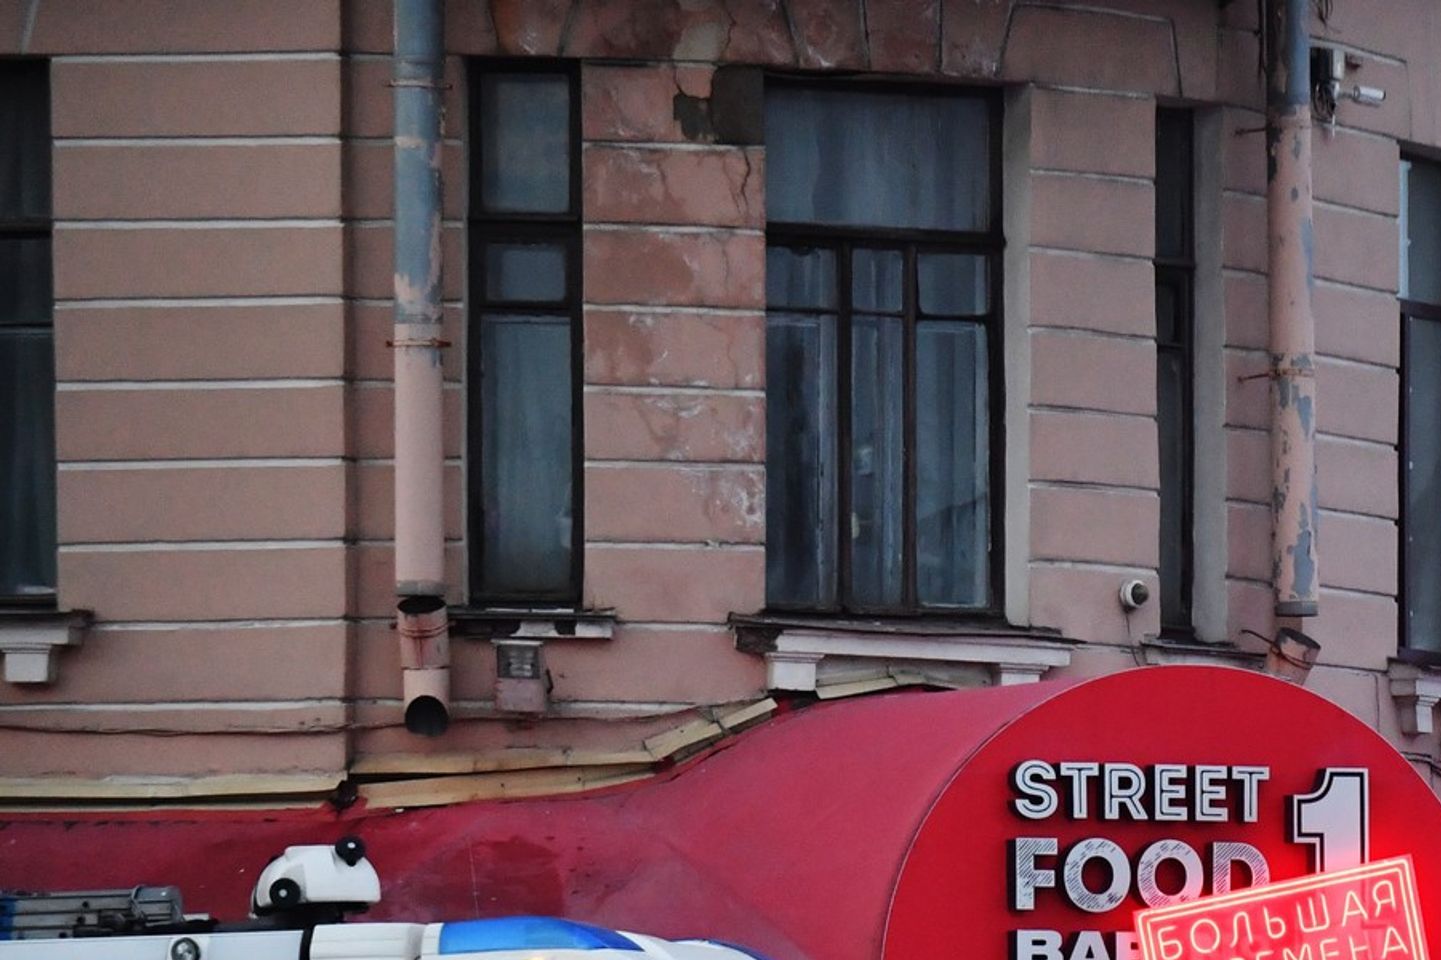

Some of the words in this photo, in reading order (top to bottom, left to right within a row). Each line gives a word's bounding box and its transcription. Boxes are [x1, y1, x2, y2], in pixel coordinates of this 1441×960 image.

[1014, 759, 1270, 823] STREET
[1014, 837, 1271, 913] FOOD
[1157, 879, 1398, 960] БОЛЬШАЯ
